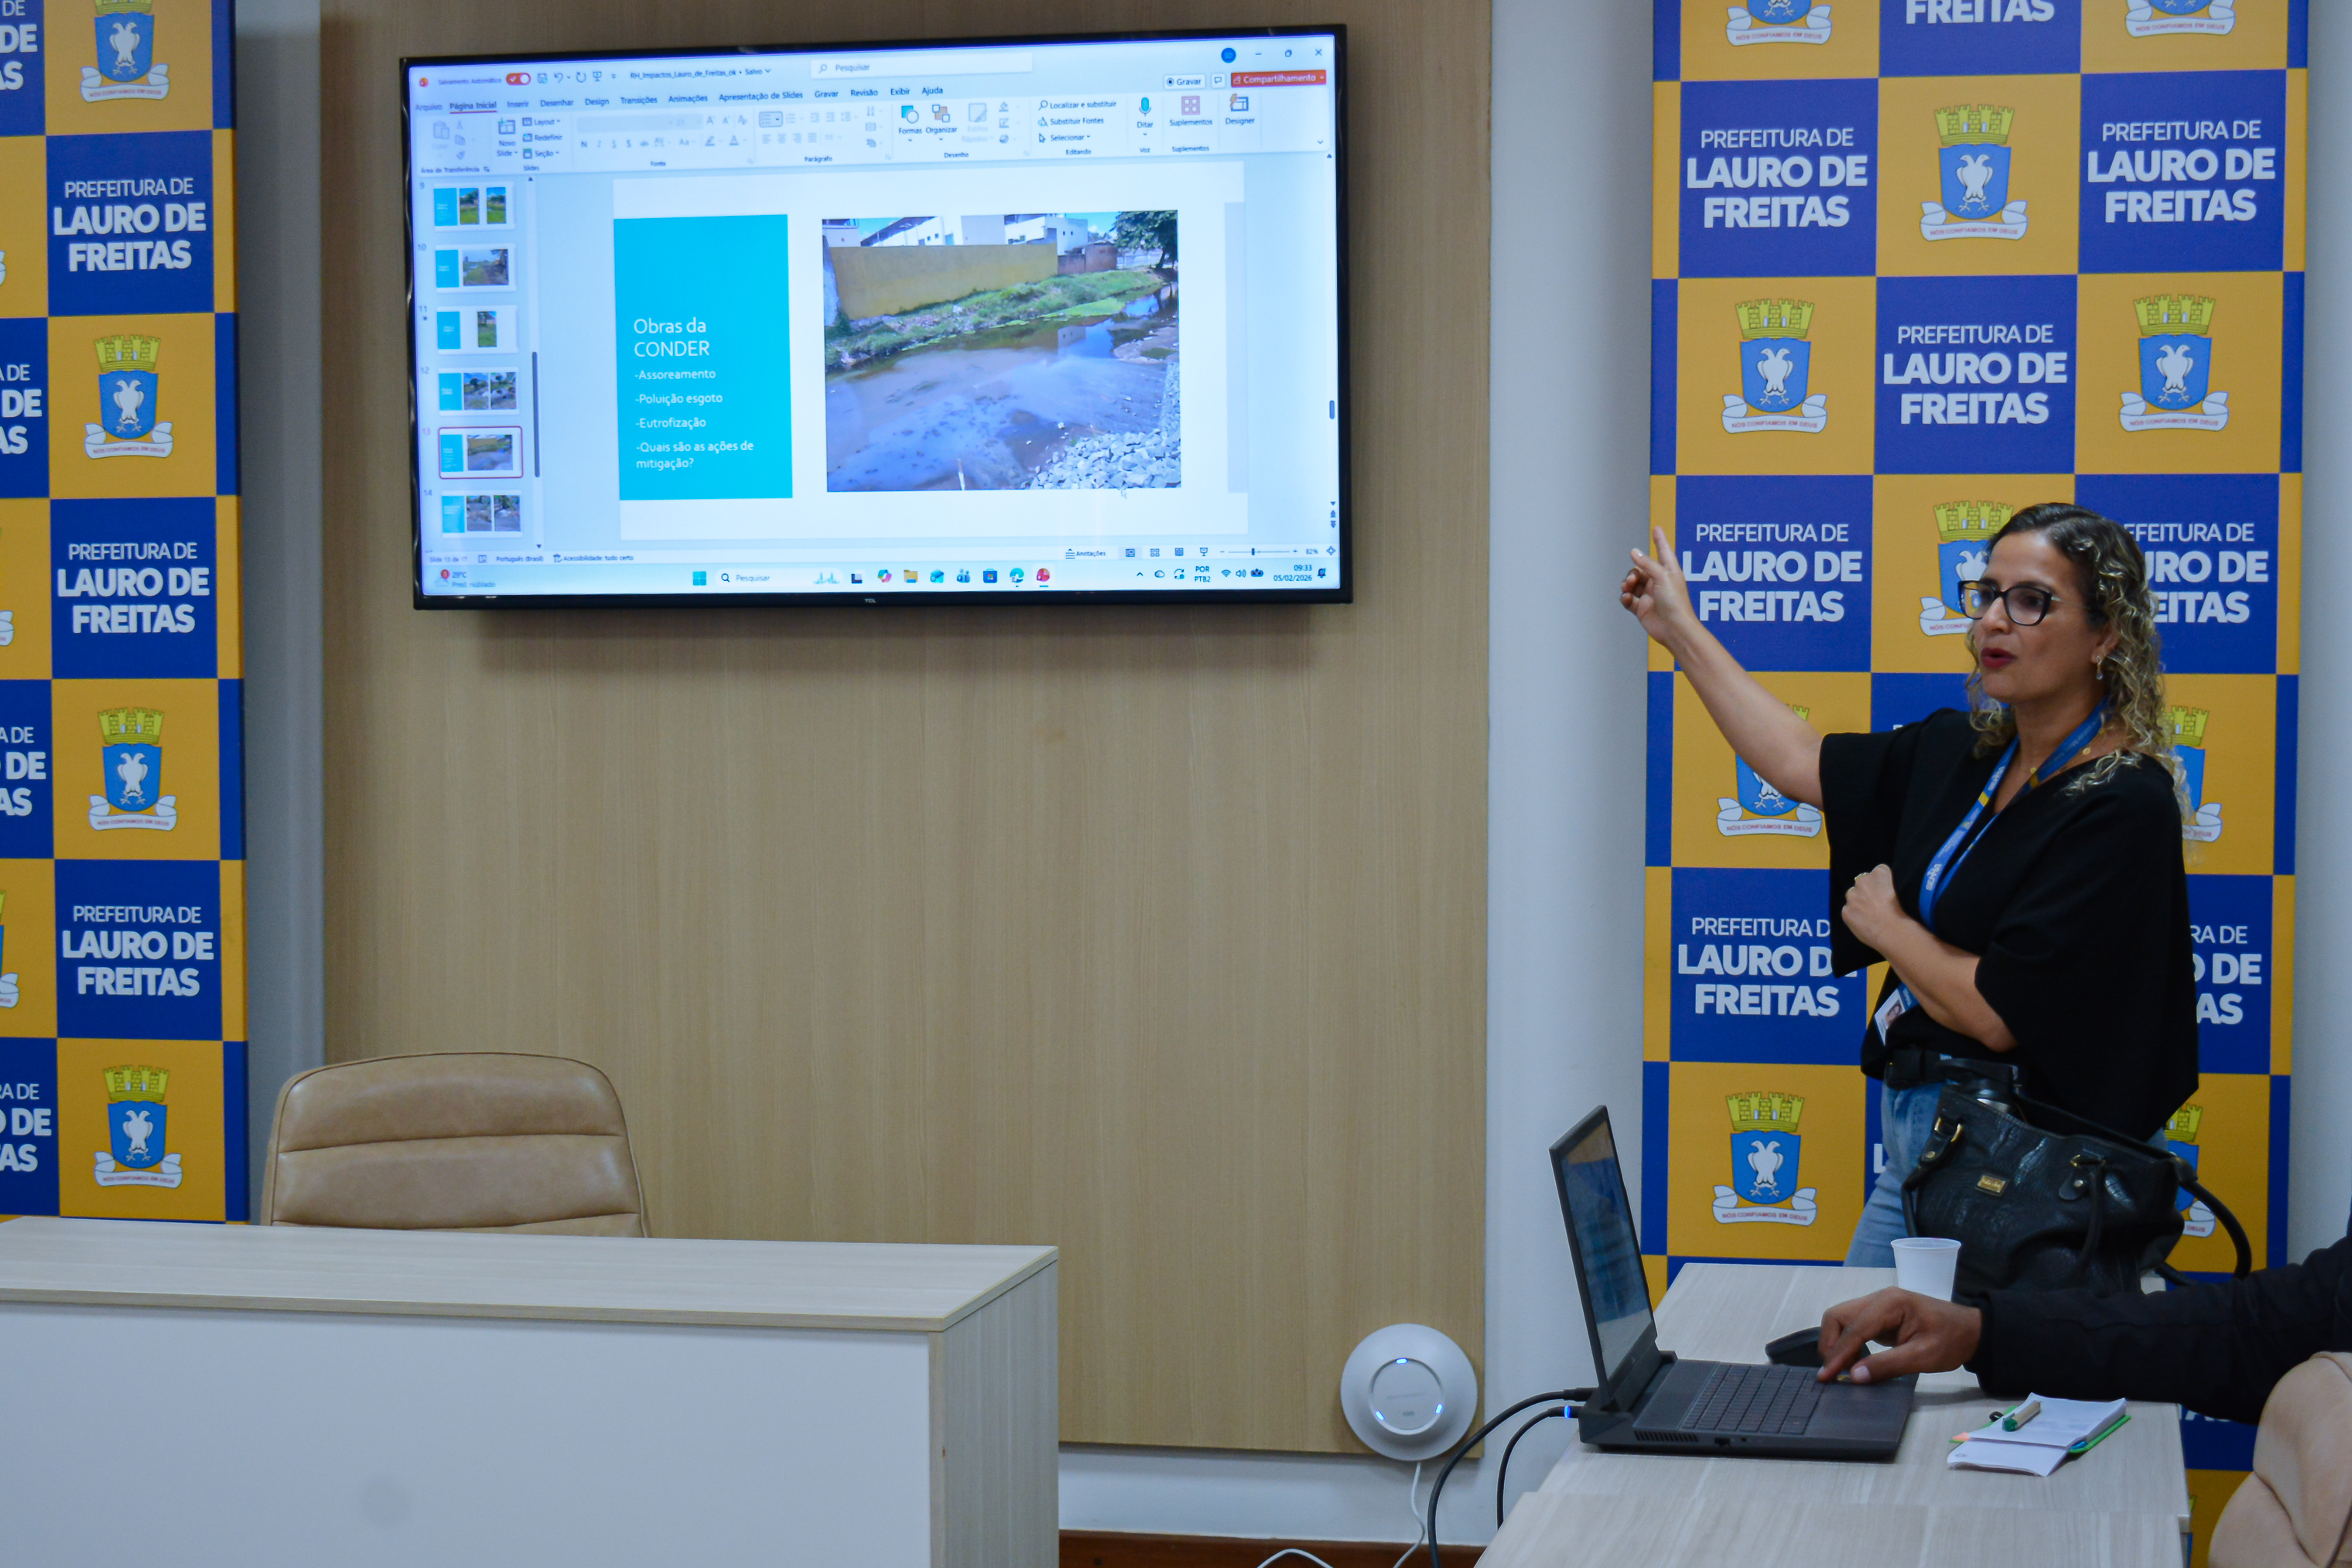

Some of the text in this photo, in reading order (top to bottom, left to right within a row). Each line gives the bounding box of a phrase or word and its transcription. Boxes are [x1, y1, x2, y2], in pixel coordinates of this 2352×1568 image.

[2, 0, 26, 16] DE
[1906, 0, 2055, 24] FREITAS
[836, 63, 870, 73] Pesquisar
[1243, 74, 1316, 84] Compartilhamento
[621, 96, 658, 104] Transições
[668, 94, 708, 104] Animações
[719, 93, 768, 102] Apresentação
[921, 86, 943, 96] Ajuda
[415, 103, 443, 111] Arquivo
[450, 102, 474, 111] Página
[585, 97, 610, 107] Design
[1050, 101, 1079, 109] Localizar
[925, 126, 958, 135] Organizar
[1169, 118, 1212, 127] Suplementos
[1226, 117, 1255, 126] Designer
[2103, 120, 2261, 142] PREFEITURA DE
[1701, 128, 1854, 149] PREFEITURA DE
[1687, 155, 1868, 189] LAURO DE
[2088, 148, 2275, 183] LAURO DE
[65, 178, 193, 198] PREFEITURA DE
[1704, 196, 1850, 228] FREITAS
[2105, 189, 2257, 223] FREITAS
[53, 203, 207, 236] LAURO DE
[69, 240, 192, 272] FREITAS
[634, 316, 706, 334] Obras da
[1898, 324, 2053, 344] PREFEITURA DE
[634, 340, 710, 357] CONDER
[7, 364, 30, 381] DE
[634, 370, 716, 380] -Assoreamento
[1883, 352, 2067, 384] LAURO DE
[2, 389, 43, 418] DE
[635, 394, 723, 406] -Poluição esgoto
[1901, 392, 2049, 425] FREITAS
[636, 417, 706, 430] -Eutrofização
[637, 442, 671, 453] -Quais
[673, 442, 692, 452] são
[708, 441, 738, 454] ações
[740, 440, 754, 451] de
[636, 457, 694, 471] mitigação?
[1696, 524, 1849, 542] PREFEITURA DE
[2226, 523, 2255, 541] DE
[69, 542, 197, 561] PREFEITURA DE
[1682, 551, 1863, 582] LAURO DE
[2219, 551, 2268, 582] DE
[57, 568, 210, 597] LAURO DE
[736, 574, 770, 582] Pesquisar
[1700, 591, 1844, 622] FREITAS
[2153, 591, 2250, 623] EITAS
[73, 604, 196, 634] FREITAS
[11, 726, 34, 743] DE
[5, 751, 46, 780] DE
[74, 905, 202, 924] PREFEITURA DE
[1692, 917, 1831, 937] PREFEITURA D
[2220, 925, 2248, 944] DE
[63, 930, 214, 961] LAURO DE
[1678, 944, 1803, 976] LAURO
[2213, 953, 2262, 985] DE
[78, 967, 200, 996] FREITAS
[1695, 983, 1839, 1016] FREITAS
[17, 1084, 39, 1100] DE
[12, 1108, 52, 1136] DE
